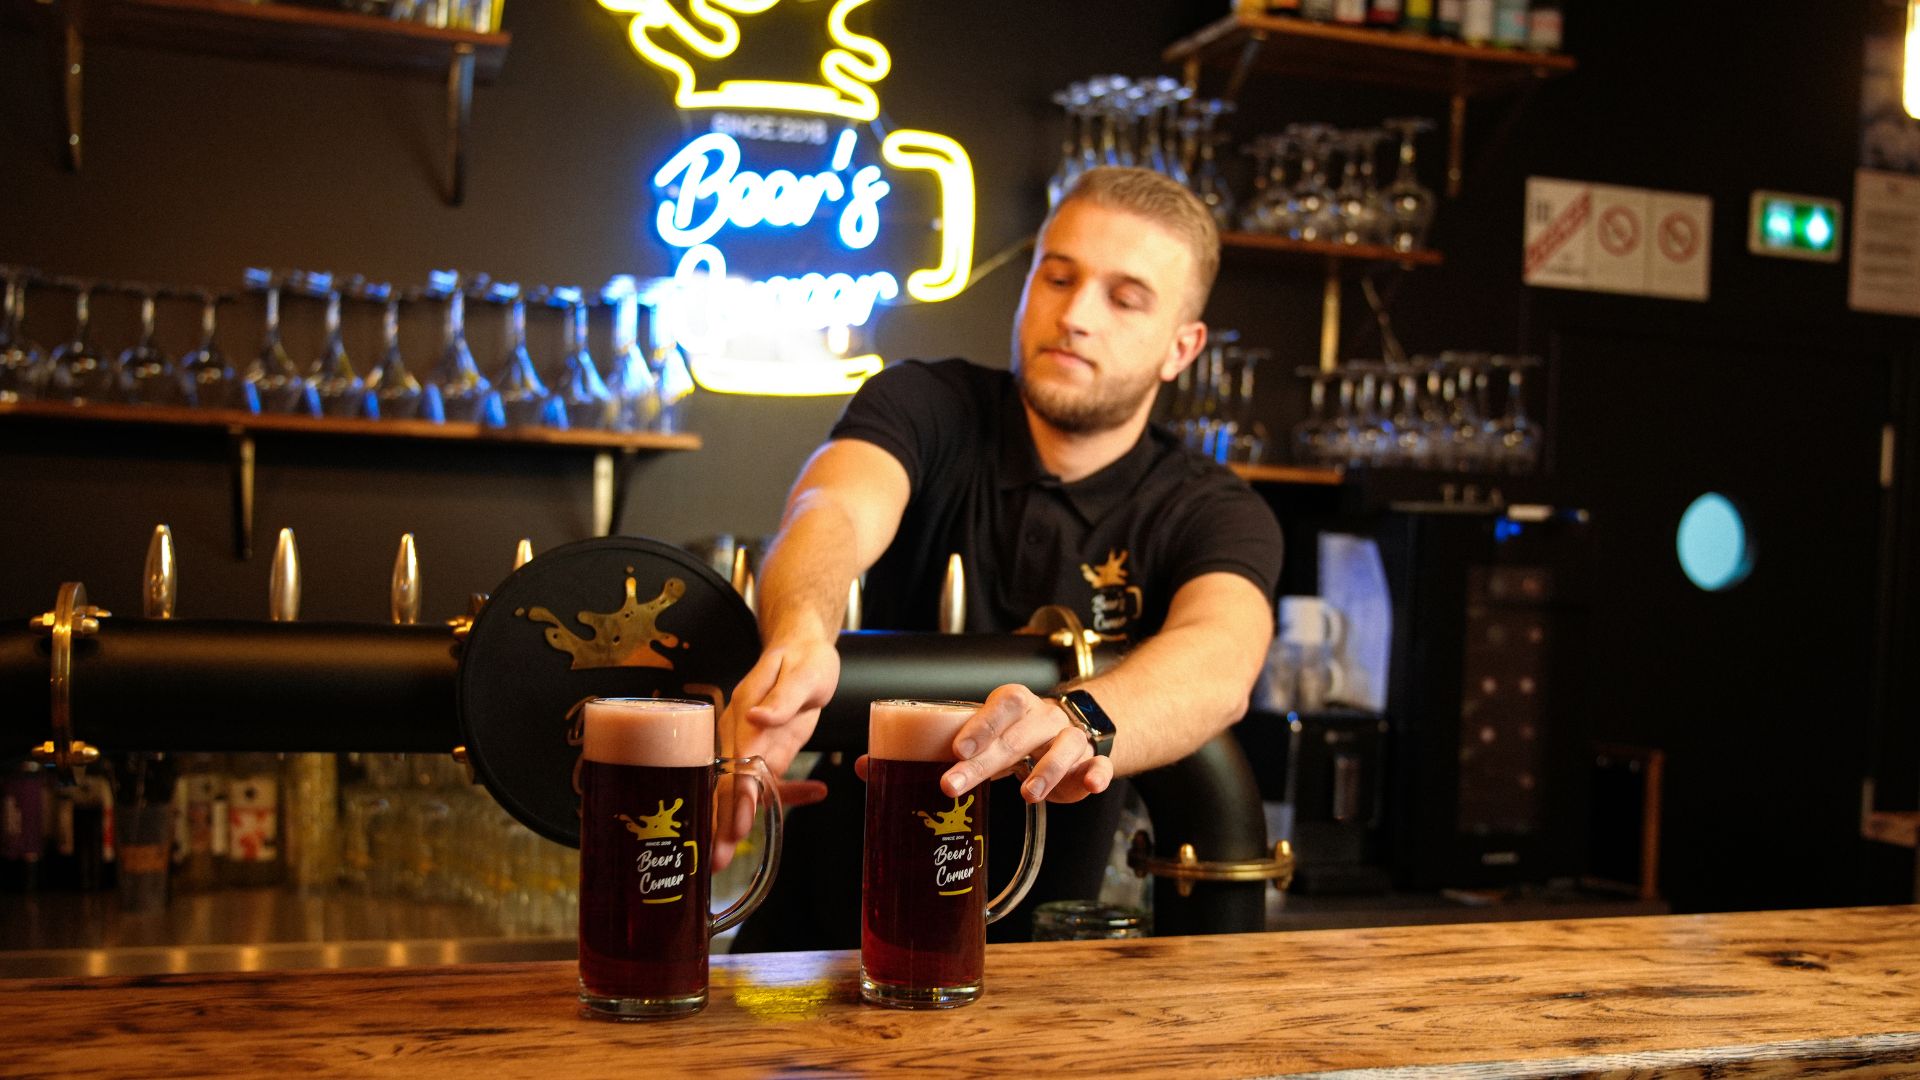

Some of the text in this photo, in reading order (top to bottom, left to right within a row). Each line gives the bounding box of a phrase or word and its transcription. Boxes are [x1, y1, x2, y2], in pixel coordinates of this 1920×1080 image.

[654, 129, 890, 249] Beer's
[636, 845, 684, 872] Beer's
[933, 840, 974, 866] Beer's
[639, 873, 685, 894] Corner
[936, 865, 974, 887] Corner
